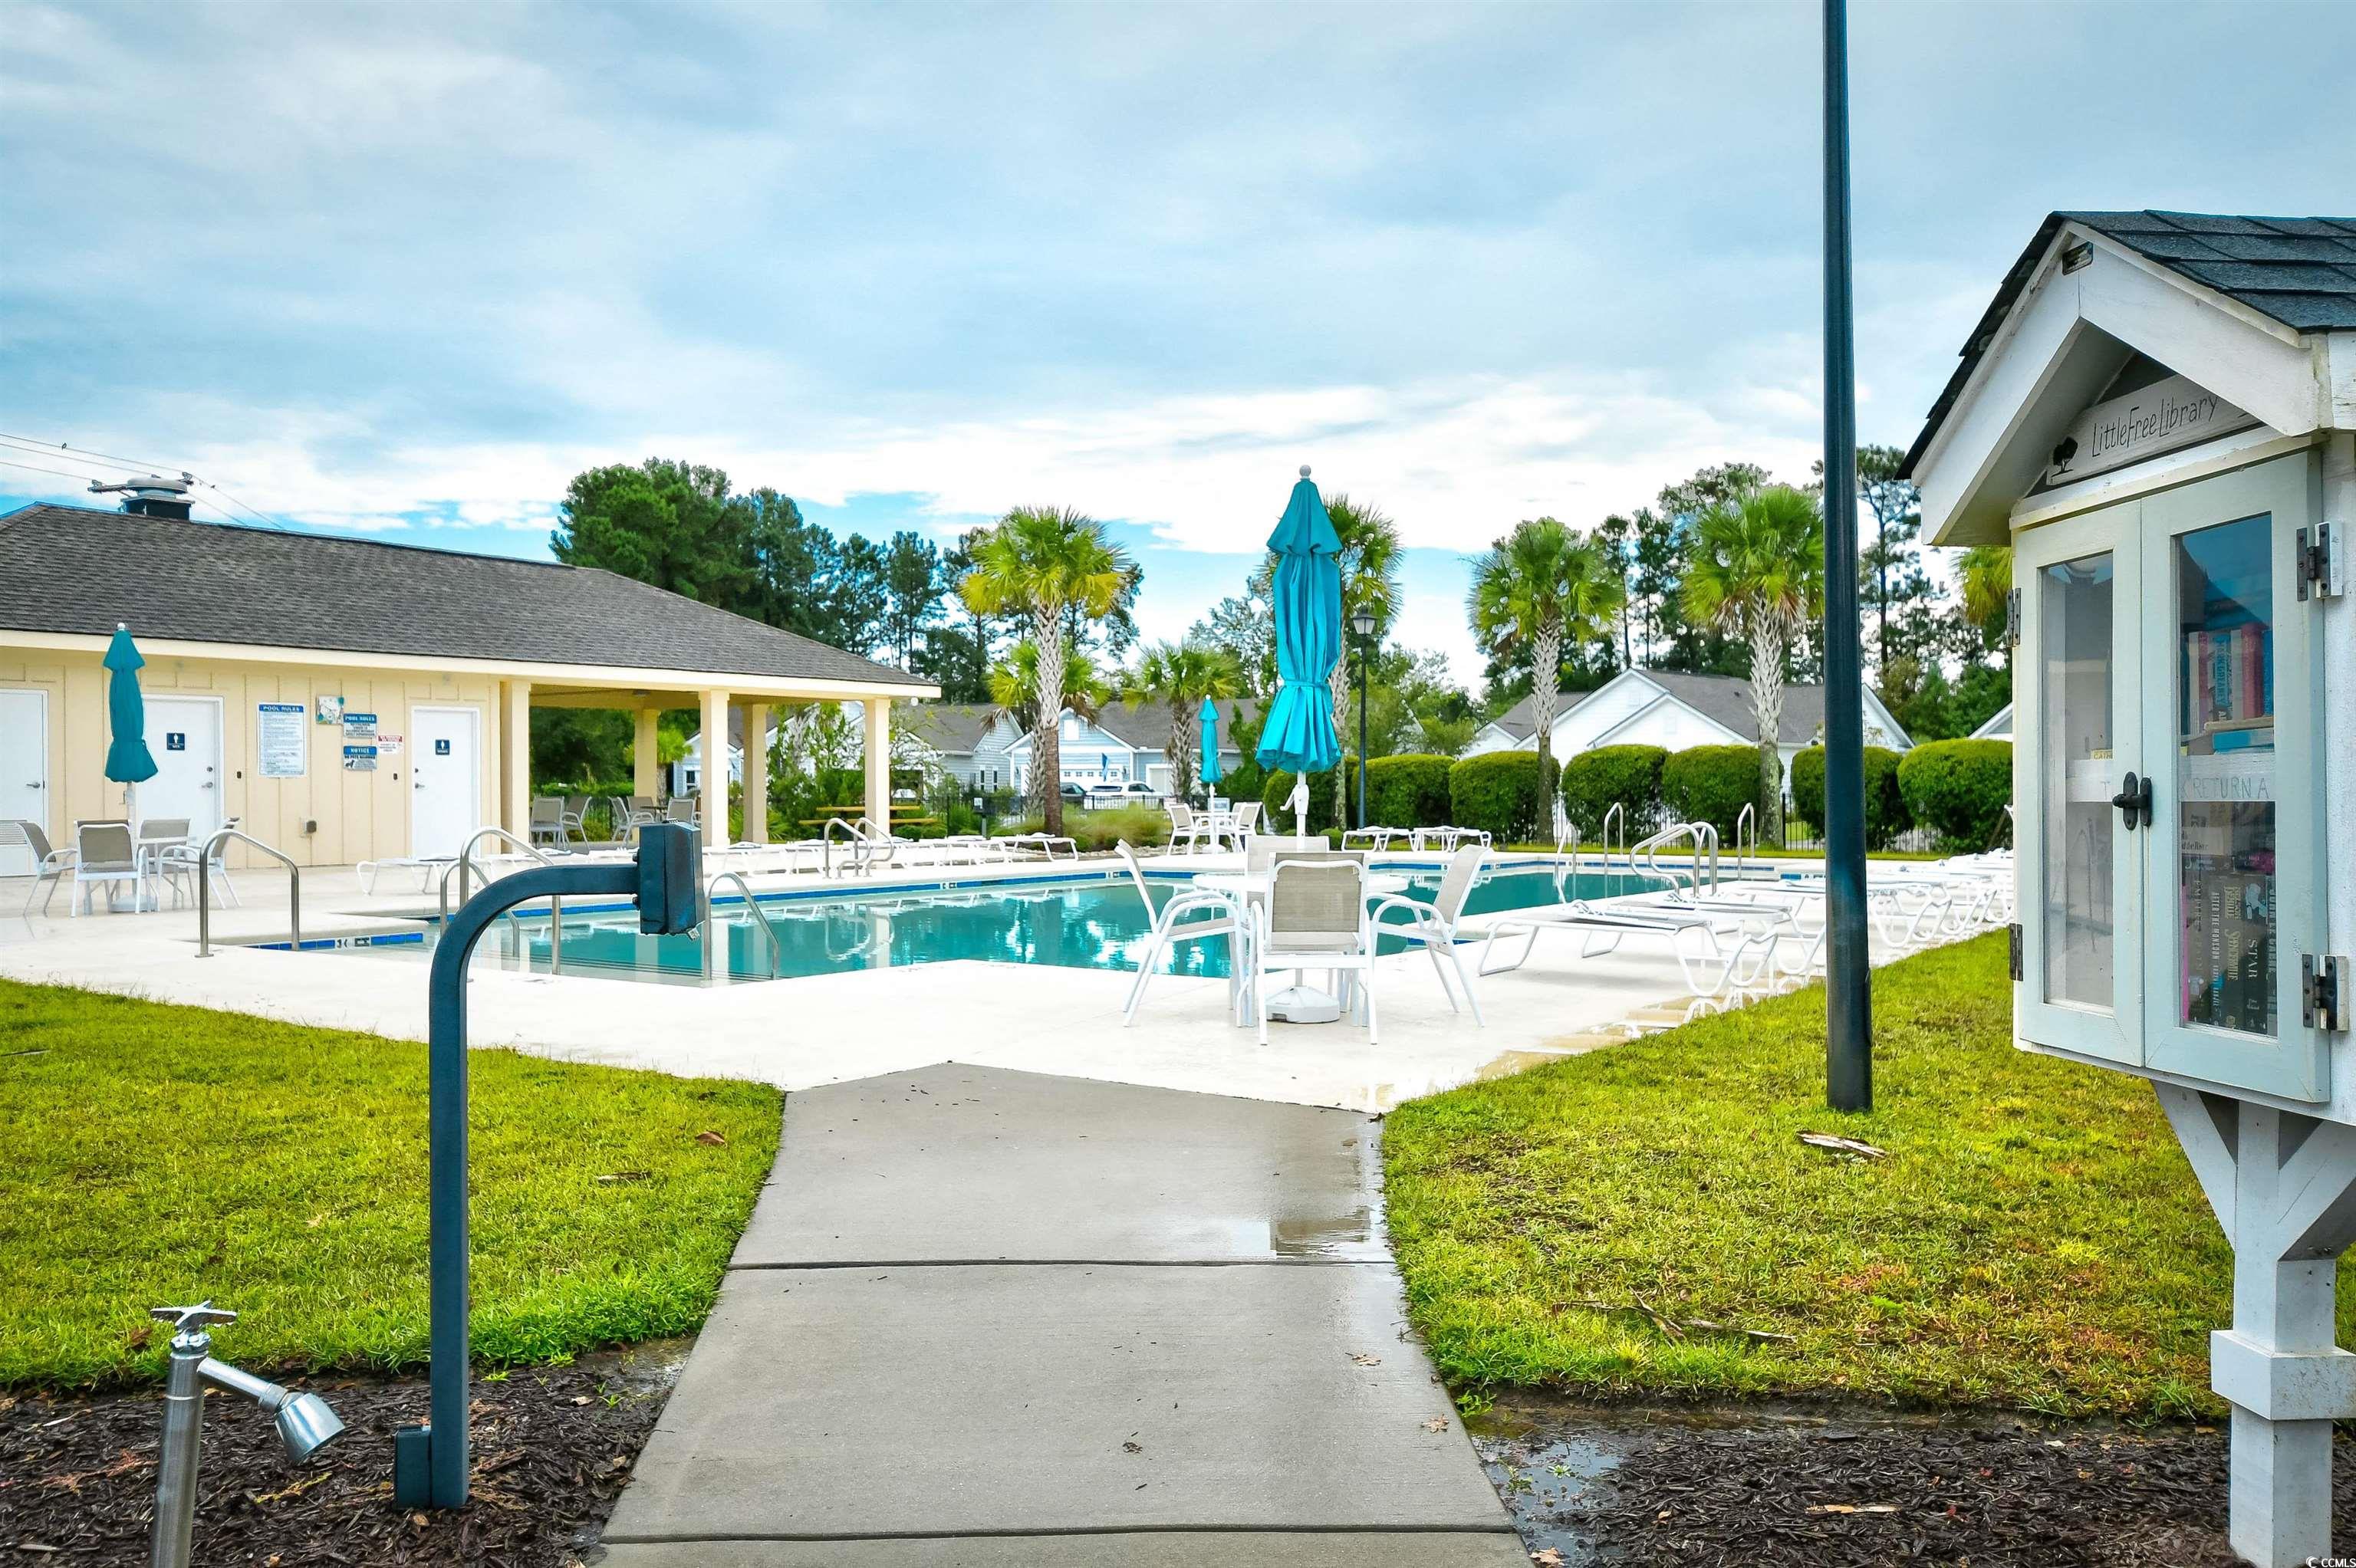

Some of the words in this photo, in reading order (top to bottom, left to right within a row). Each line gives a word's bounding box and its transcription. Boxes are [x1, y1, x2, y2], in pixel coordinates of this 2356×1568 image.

[2193, 776, 2252, 799] RETURN
[2257, 777, 2271, 799] A
[2211, 892, 2220, 911] AFTER
[2211, 914, 2220, 925] THE
[2212, 929, 2220, 959] MONSOON
[2248, 938, 2258, 978] STAR
